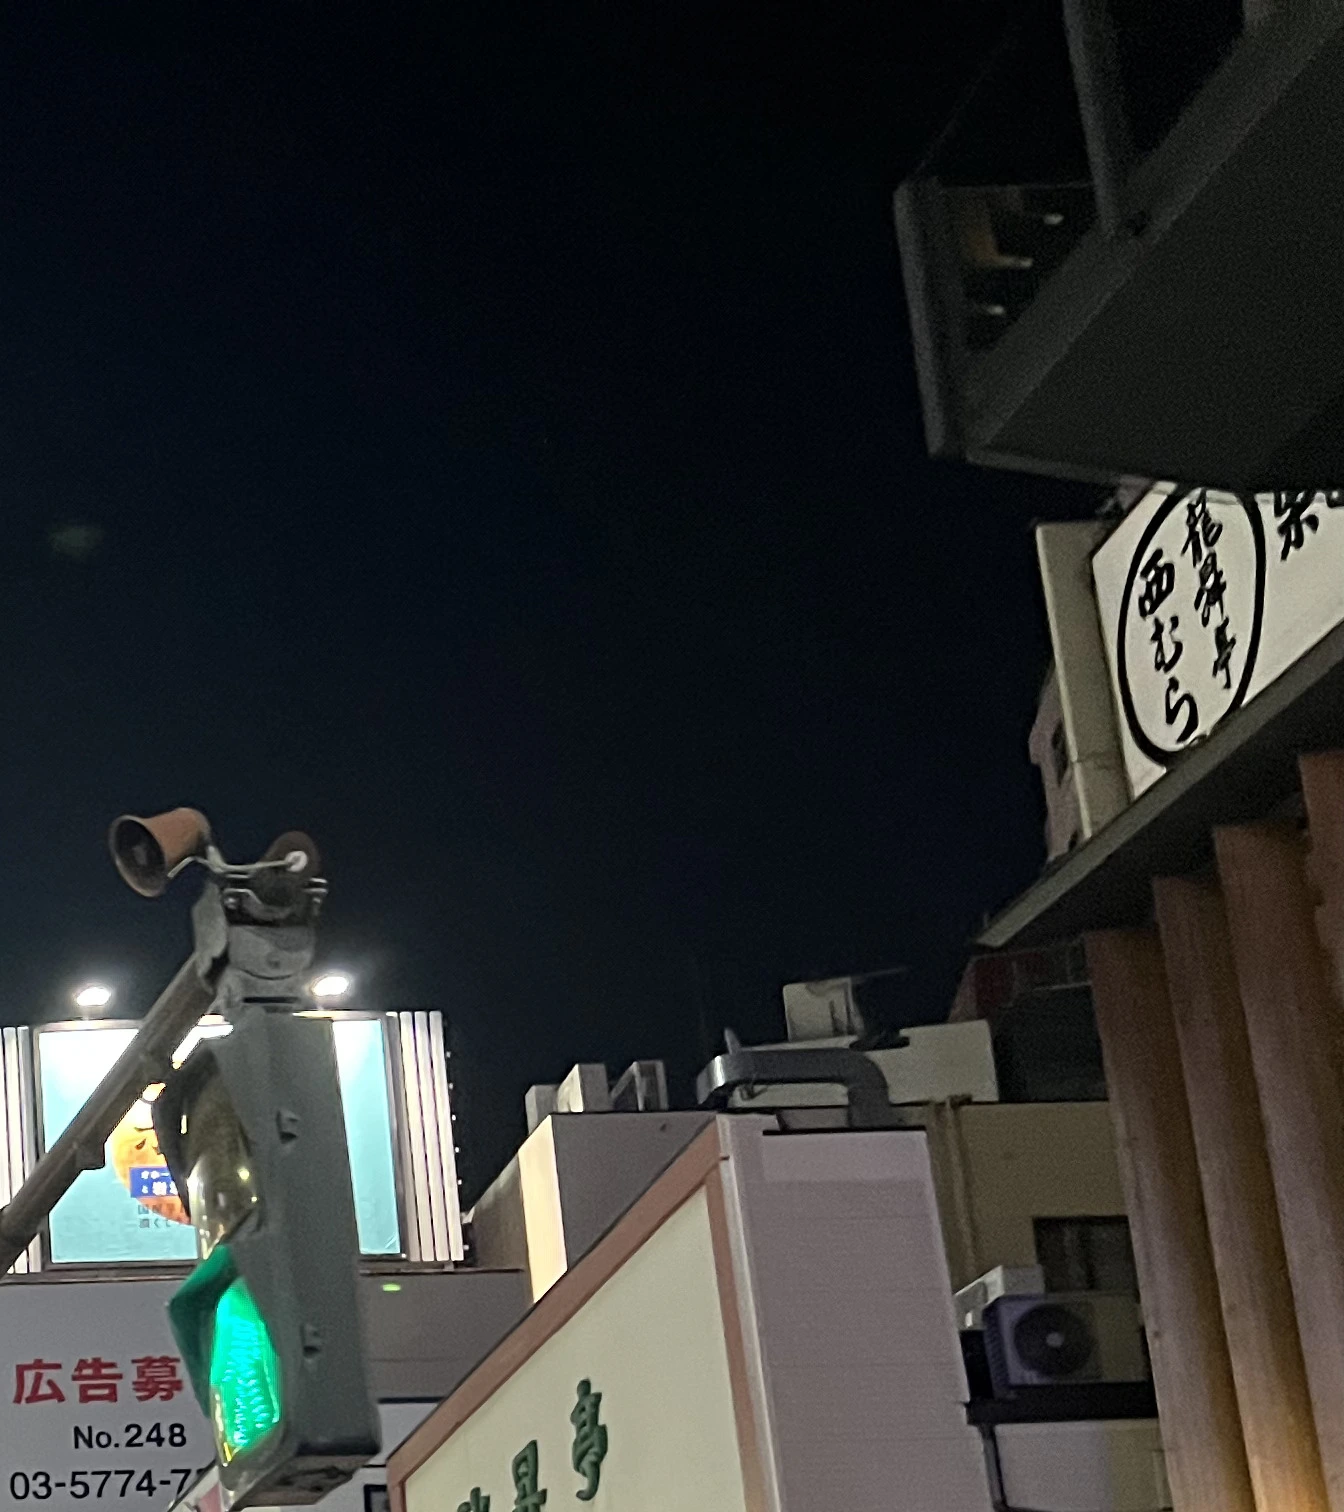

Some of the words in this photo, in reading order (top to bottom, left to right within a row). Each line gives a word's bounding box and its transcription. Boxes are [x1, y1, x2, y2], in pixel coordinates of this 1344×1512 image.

[12, 1357, 184, 1405] 広告募
[73, 1423, 187, 1450] No.248
[9, 1468, 205, 1500] 03-5774-7
